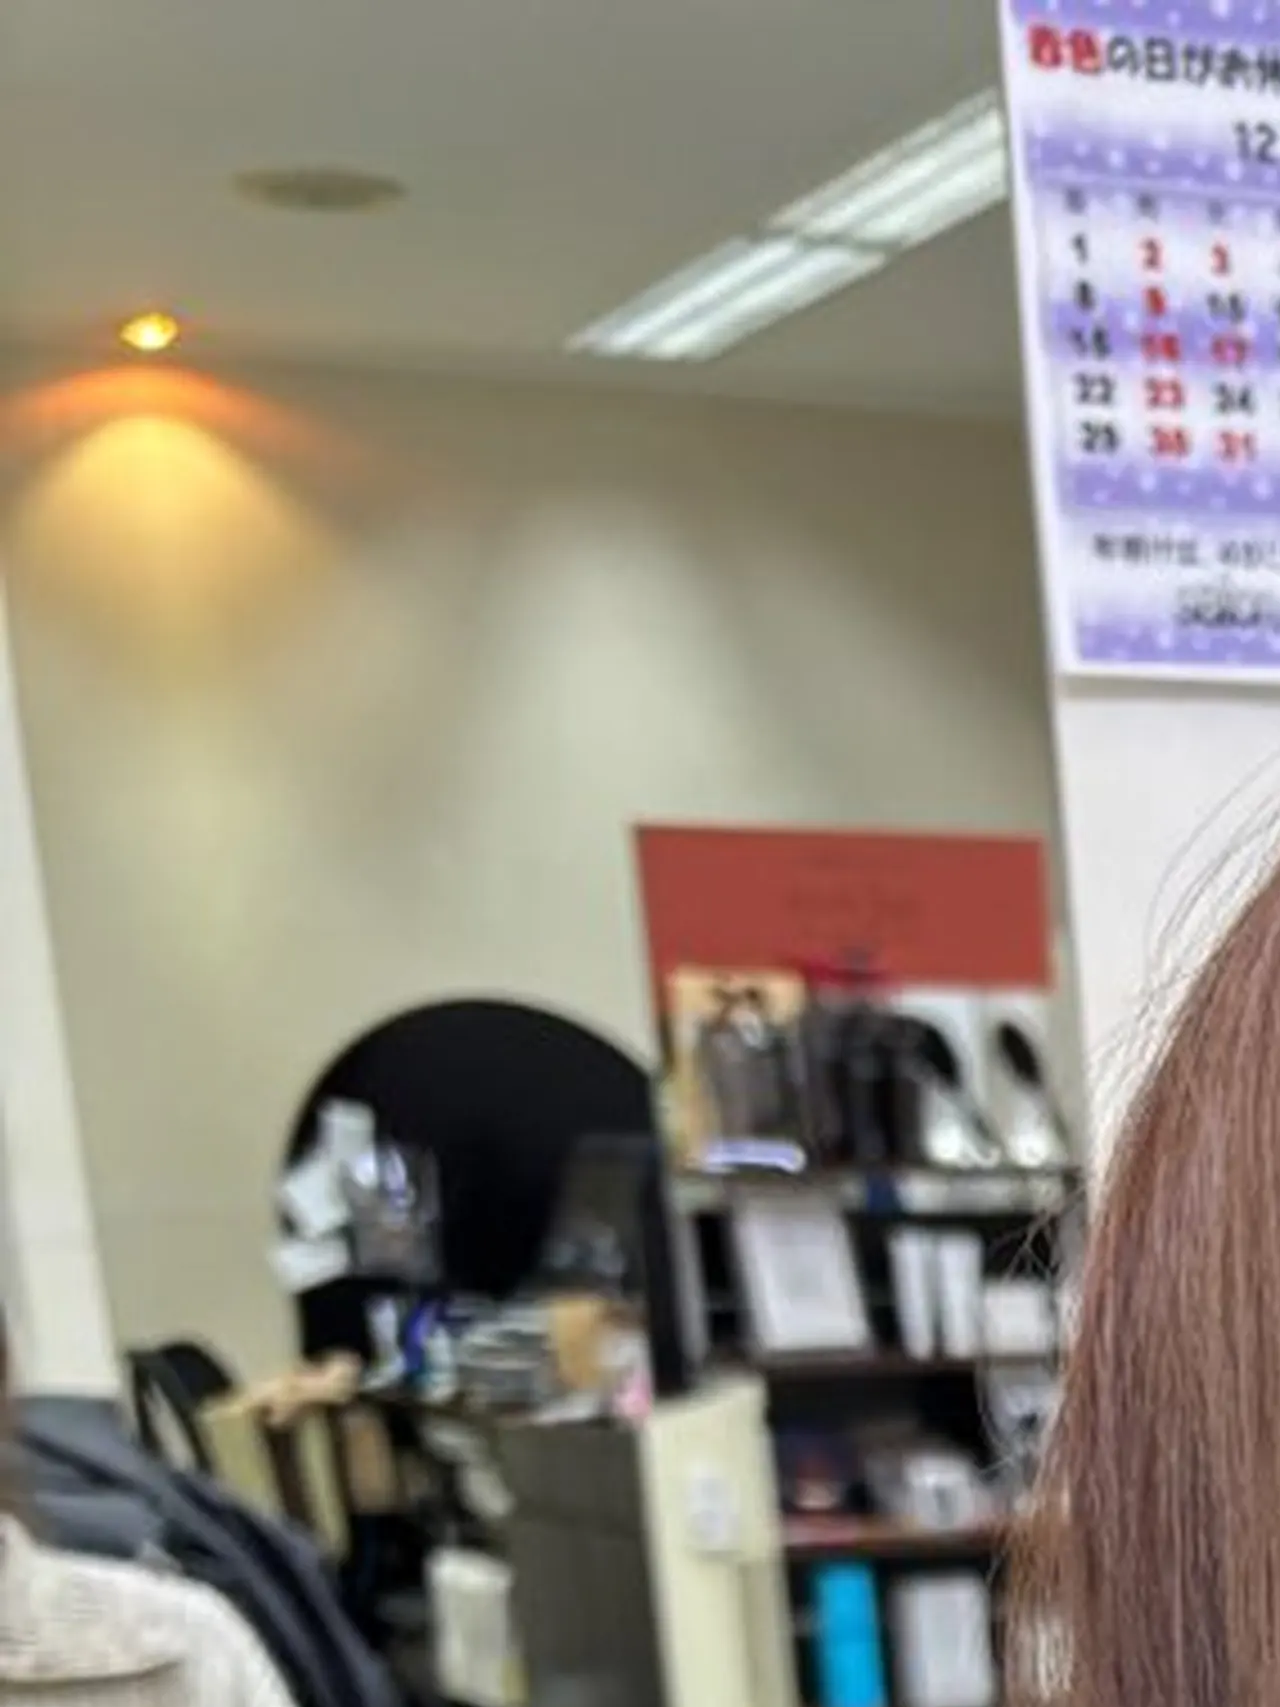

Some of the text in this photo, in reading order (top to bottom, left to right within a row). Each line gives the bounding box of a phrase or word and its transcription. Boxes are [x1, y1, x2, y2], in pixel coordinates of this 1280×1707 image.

[1071, 232, 1089, 265] 1
[1141, 236, 1163, 271] 2
[1210, 242, 1230, 275] 3
